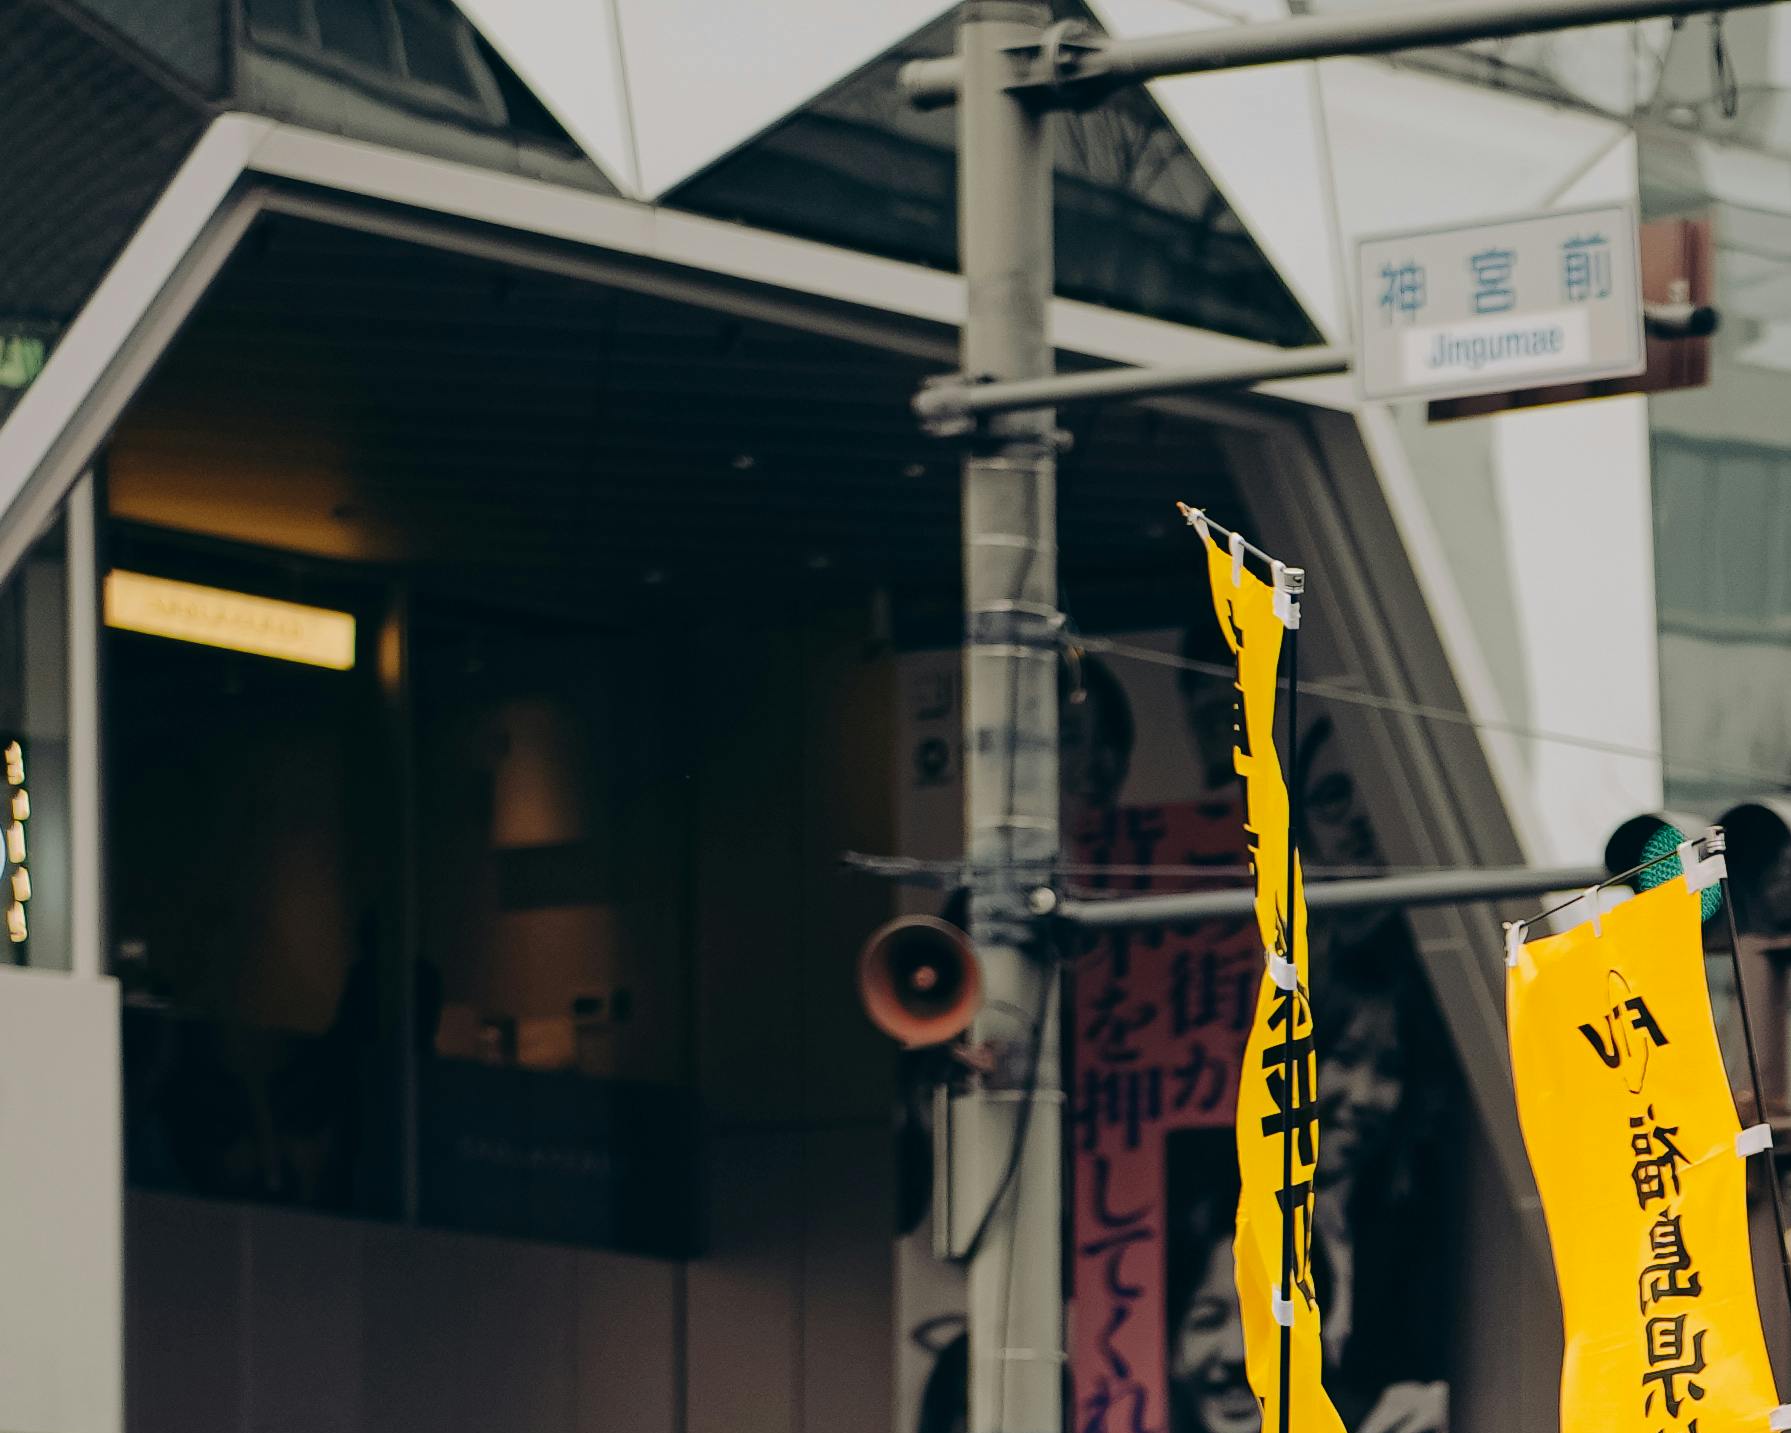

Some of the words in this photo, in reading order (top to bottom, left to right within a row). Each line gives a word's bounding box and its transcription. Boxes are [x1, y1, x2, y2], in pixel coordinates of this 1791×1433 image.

[1379, 232, 1612, 326] 神宮前
[1430, 325, 1563, 369] Jingumae
